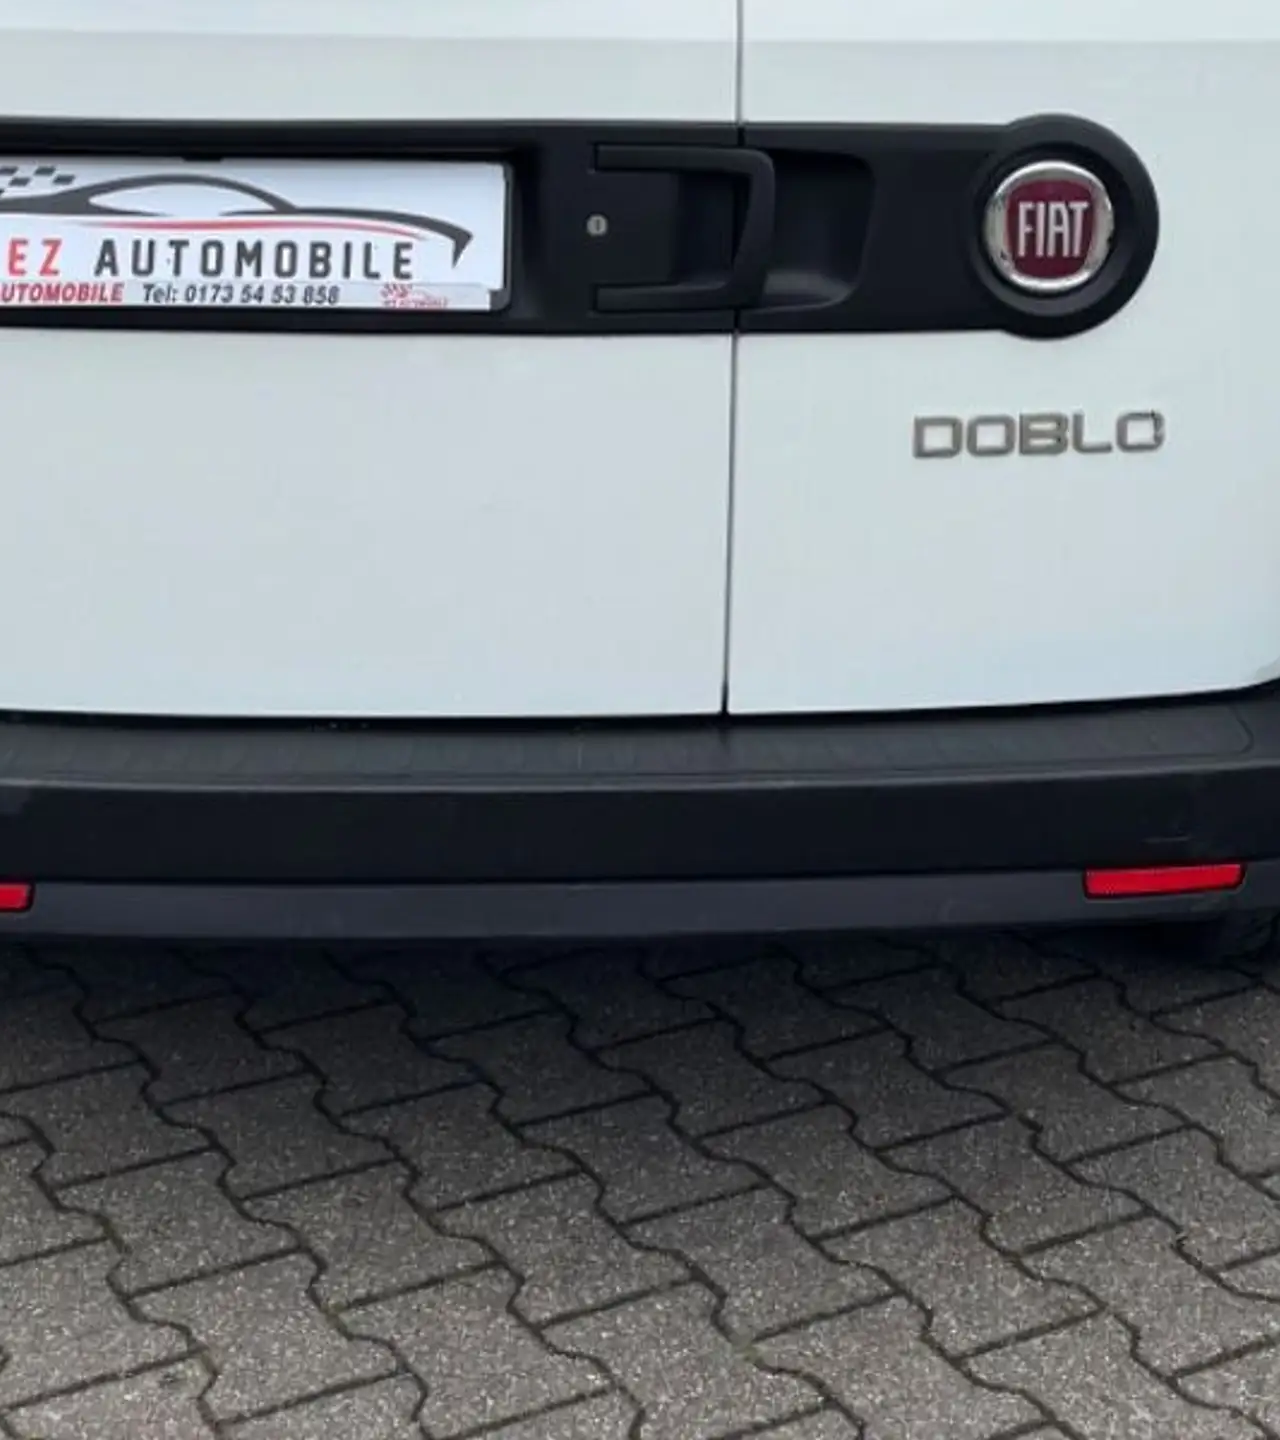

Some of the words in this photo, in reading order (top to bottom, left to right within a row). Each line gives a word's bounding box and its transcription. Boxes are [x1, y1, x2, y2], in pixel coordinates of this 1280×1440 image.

[1017, 201, 1090, 258] FIAT
[93, 238, 414, 280] AUTOMOBILE
[142, 283, 178, 304] Tel:
[184, 283, 235, 304] 0173
[239, 283, 266, 304] 54
[272, 283, 297, 304] 53
